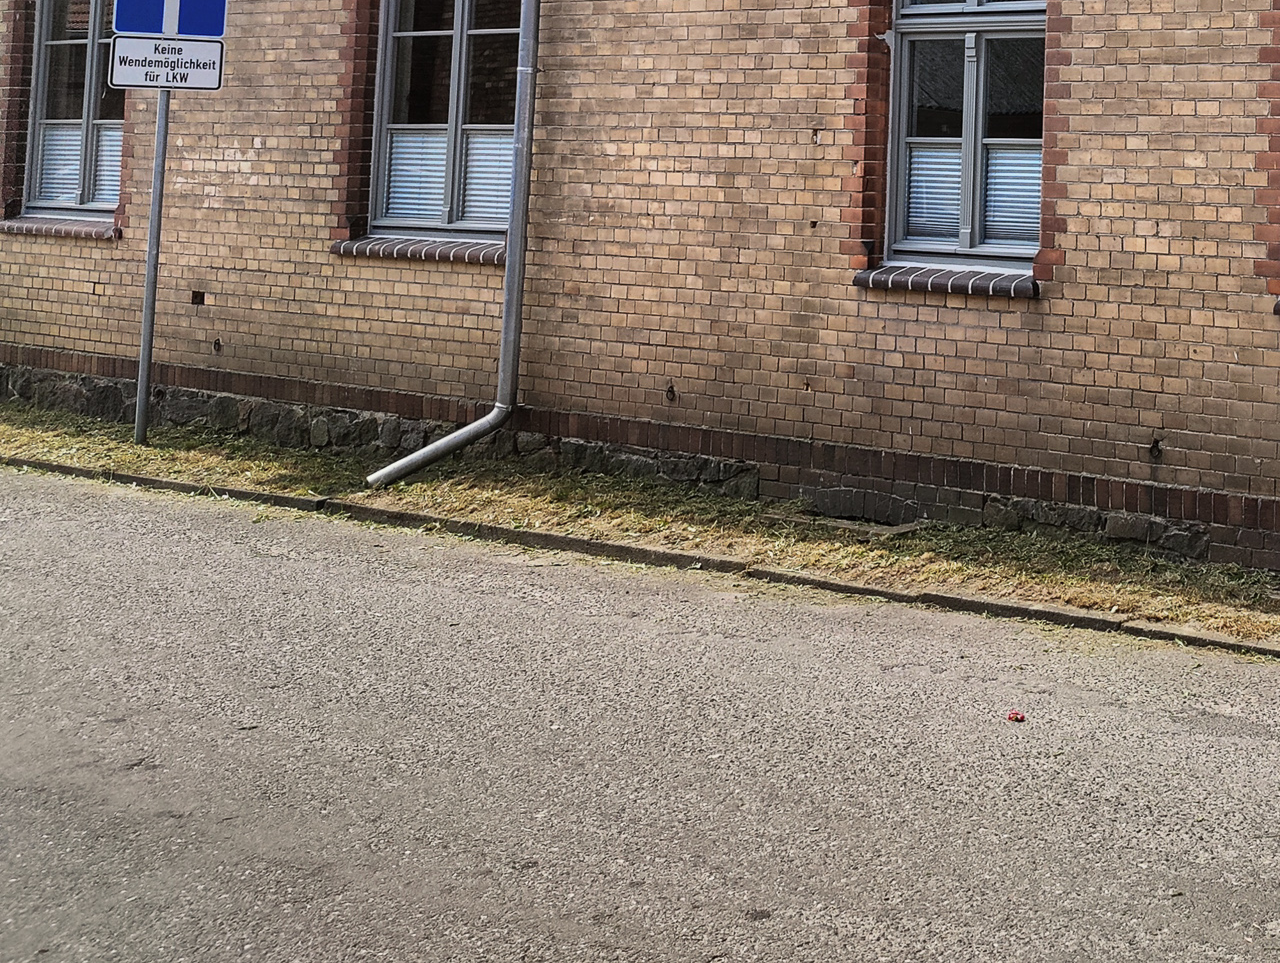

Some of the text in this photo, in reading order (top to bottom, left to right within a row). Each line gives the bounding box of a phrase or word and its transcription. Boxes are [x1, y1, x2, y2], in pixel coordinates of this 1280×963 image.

[154, 43, 183, 55] Keine
[118, 56, 216, 71] Wendemöglichkeit
[144, 71, 189, 83] für LKW
